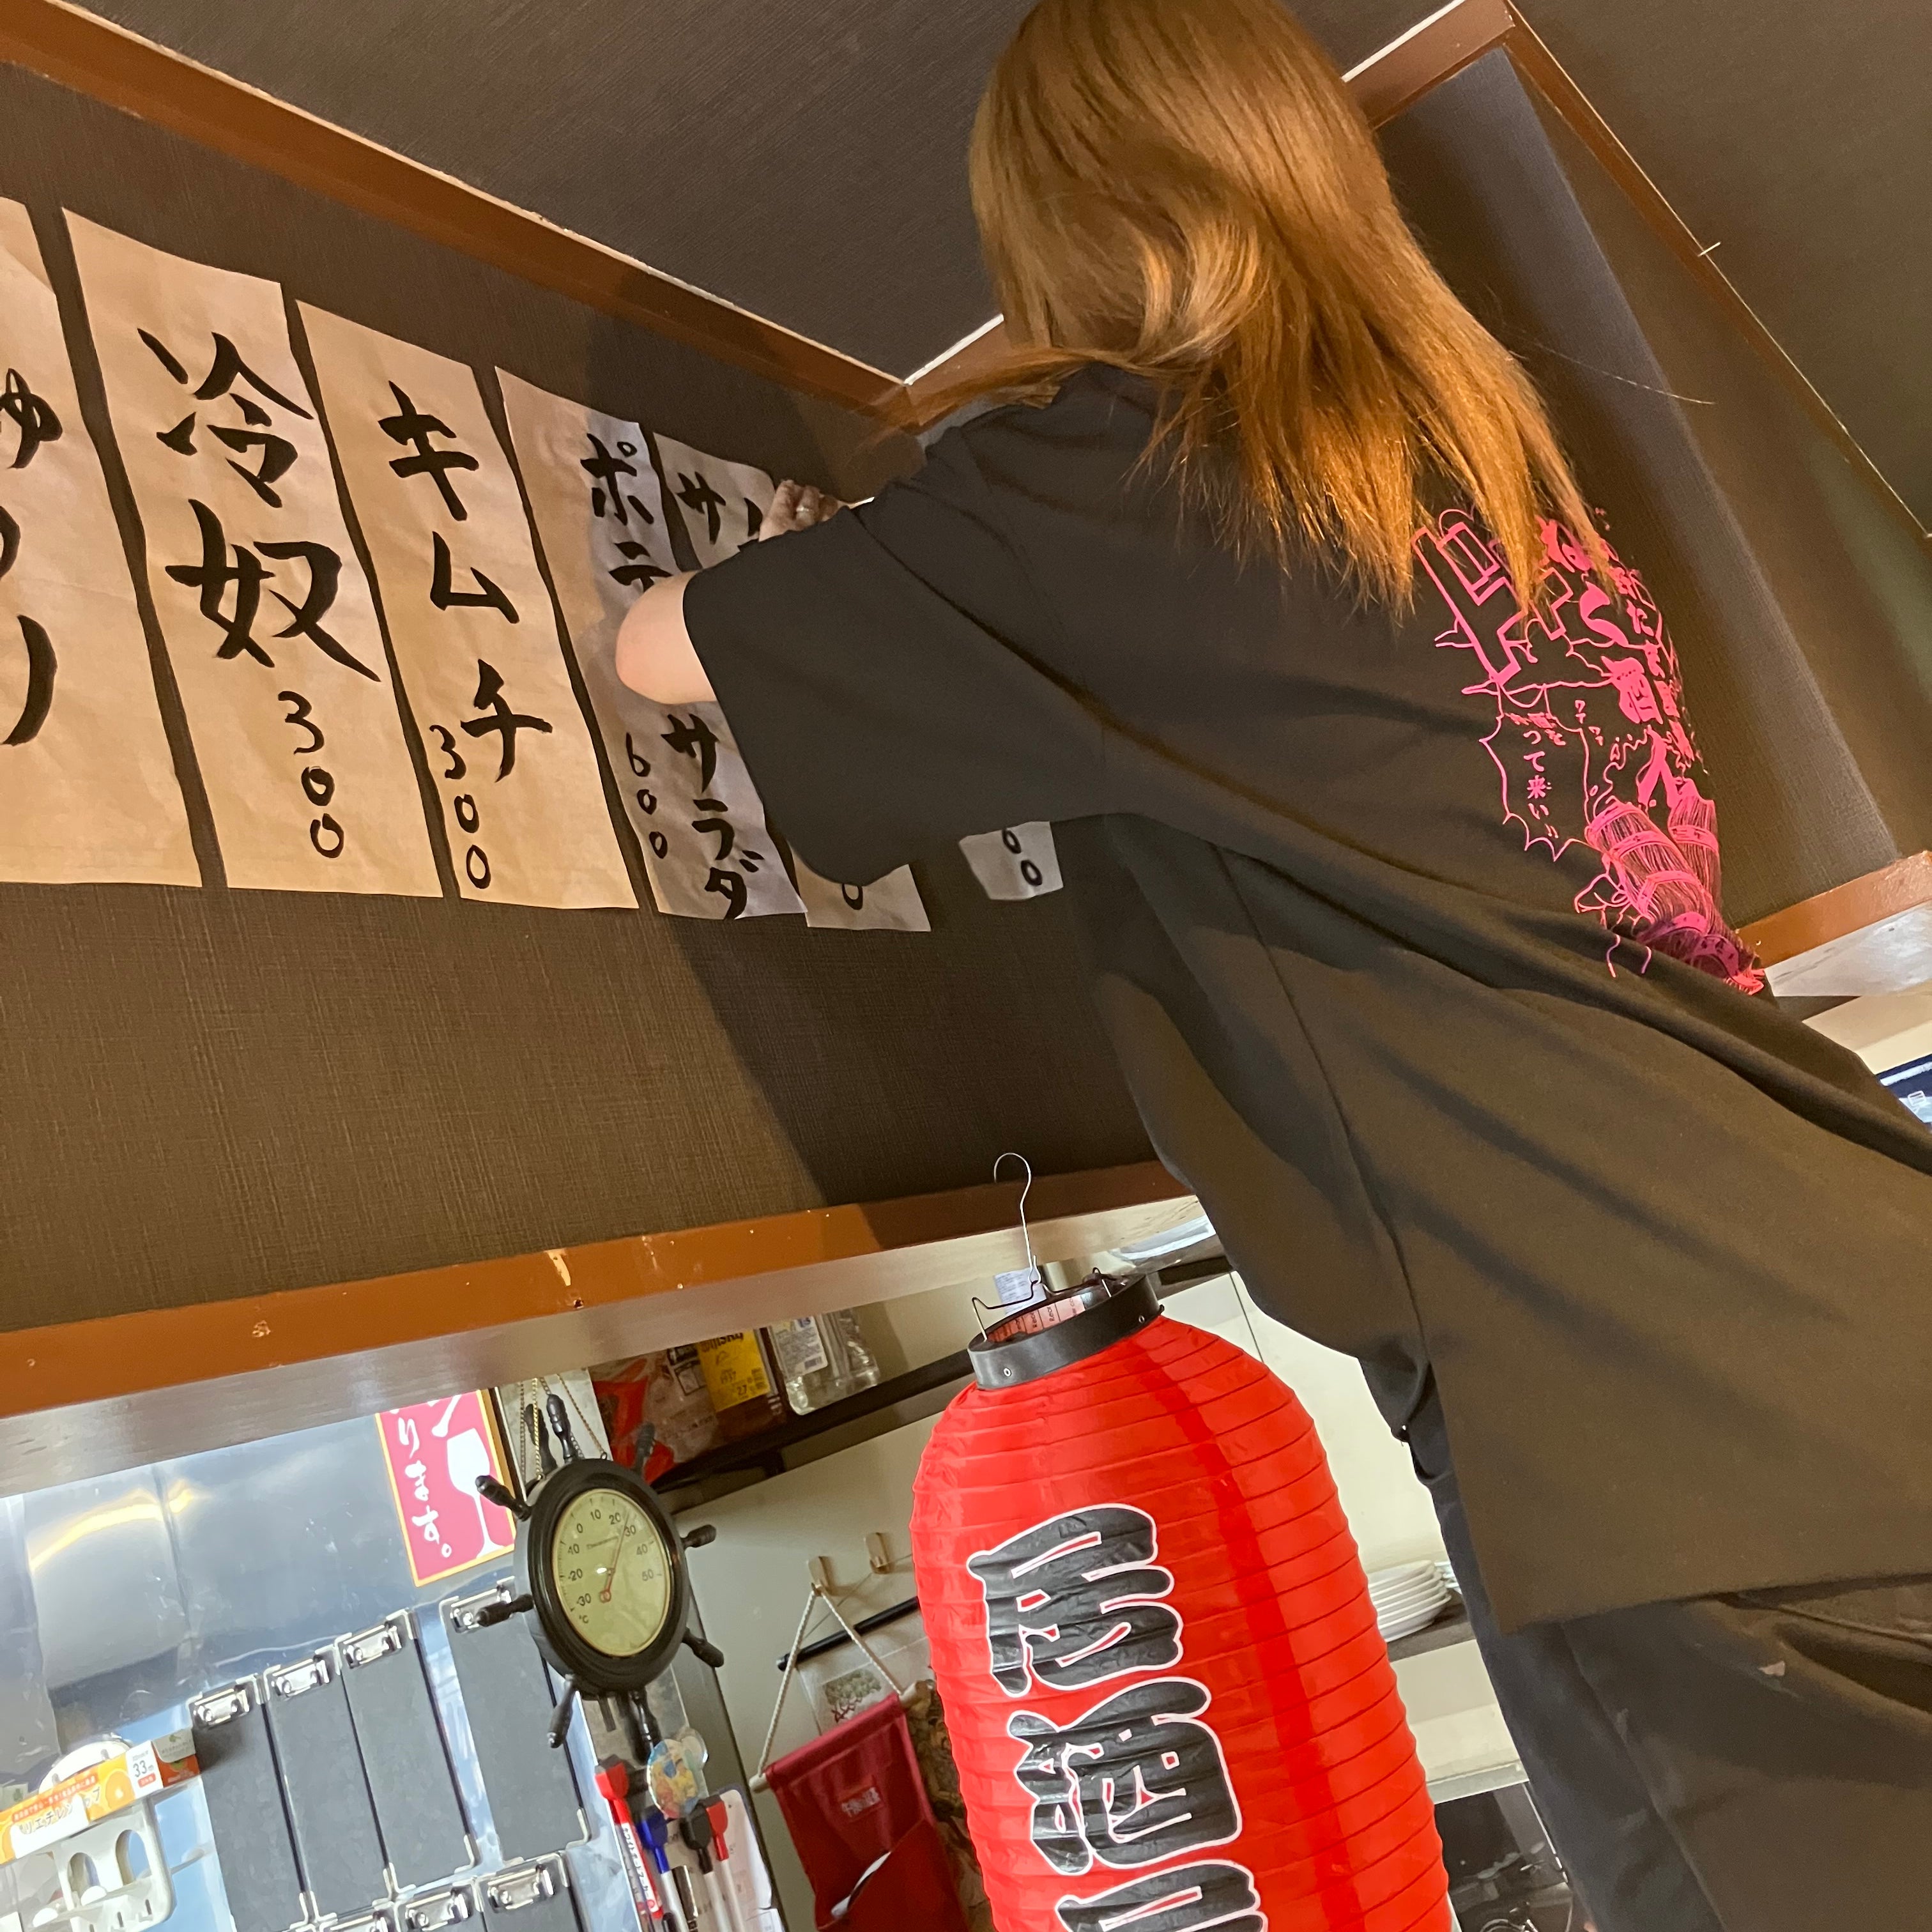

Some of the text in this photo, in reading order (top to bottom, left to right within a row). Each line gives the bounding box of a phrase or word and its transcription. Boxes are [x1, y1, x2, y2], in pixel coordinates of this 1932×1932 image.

[138, 332, 381, 682] 冷奴
[378, 381, 553, 783] キムチ
[278, 691, 345, 858] 300
[429, 724, 492, 889] 300
[390, 1408, 452, 1558] ります。
[590, 1509, 601, 1521] 10
[609, 1512, 621, 1526] 20
[576, 1524, 583, 1533] 0
[624, 1525, 636, 1538] 30
[636, 1543, 648, 1556] 40
[642, 1569, 654, 1582] 50
